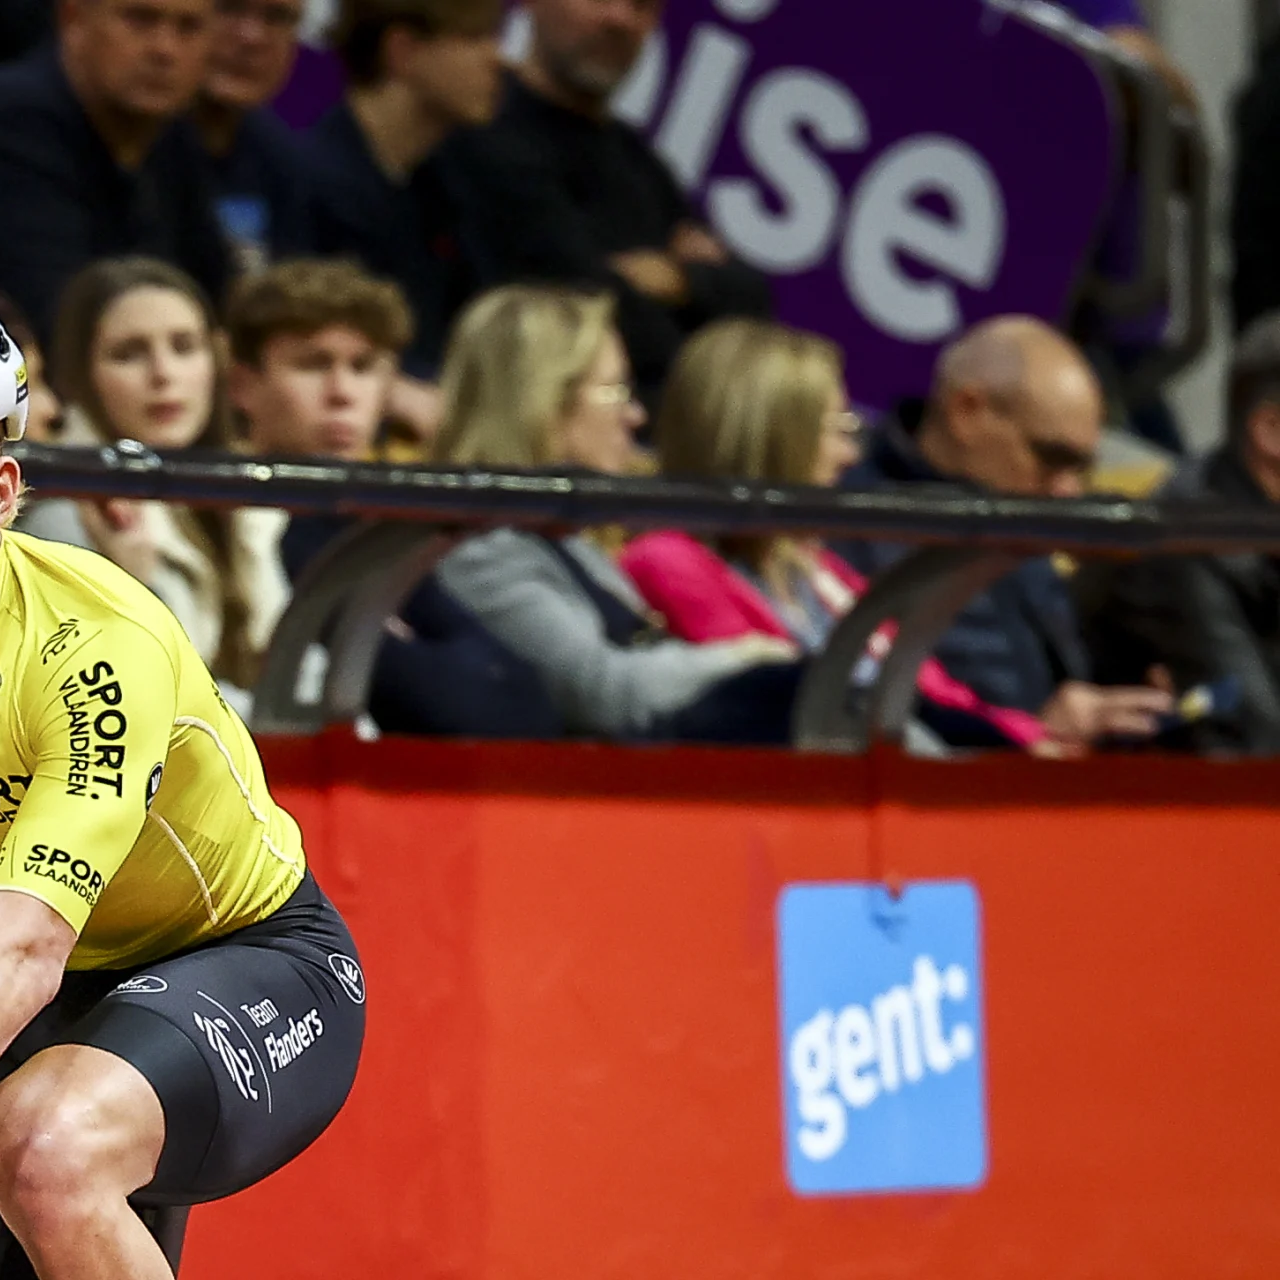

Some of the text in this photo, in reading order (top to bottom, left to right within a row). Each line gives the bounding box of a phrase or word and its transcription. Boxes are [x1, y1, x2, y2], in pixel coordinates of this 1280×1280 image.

[78, 660, 127, 801] SPORT.
[240, 997, 280, 1029] Team
[263, 1007, 325, 1074] Flanders
[790, 953, 975, 1162] gent:
